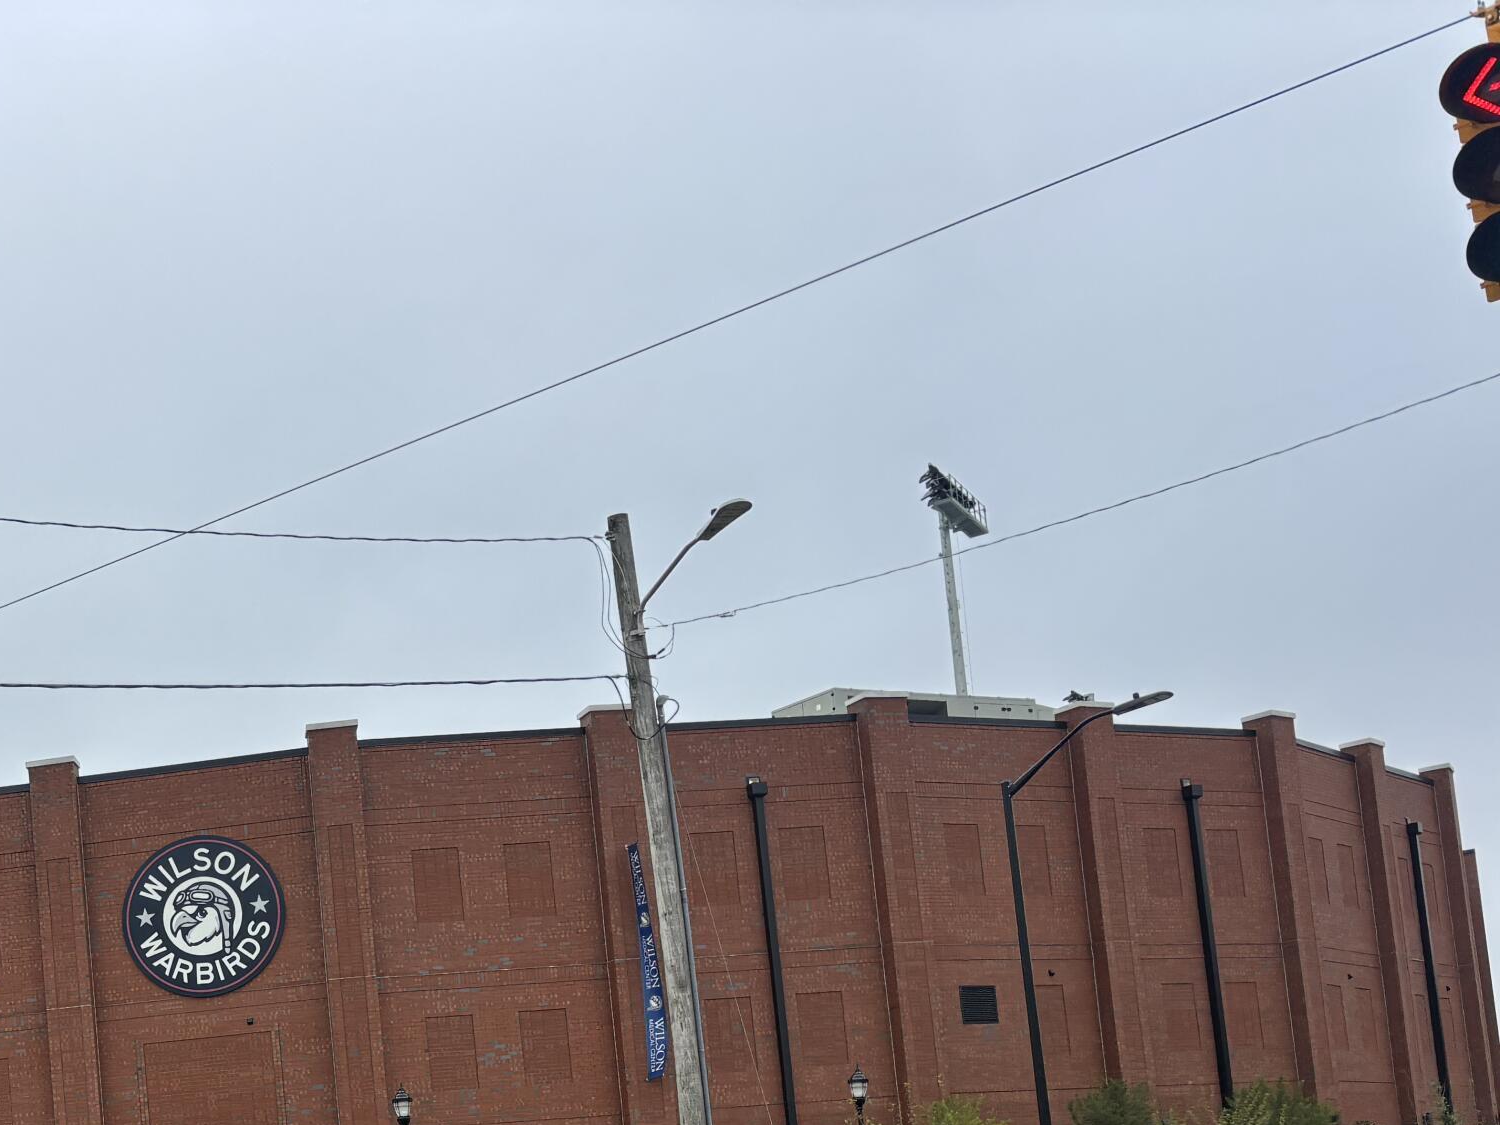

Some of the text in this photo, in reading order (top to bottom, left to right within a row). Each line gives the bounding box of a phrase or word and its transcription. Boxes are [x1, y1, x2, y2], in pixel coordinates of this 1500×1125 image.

[139, 848, 260, 902] WILSON
[633, 850, 648, 905] WILSON
[140, 920, 271, 985] WARBIRDS
[646, 933, 660, 988] WILSON
[654, 1017, 666, 1072] WILSON
